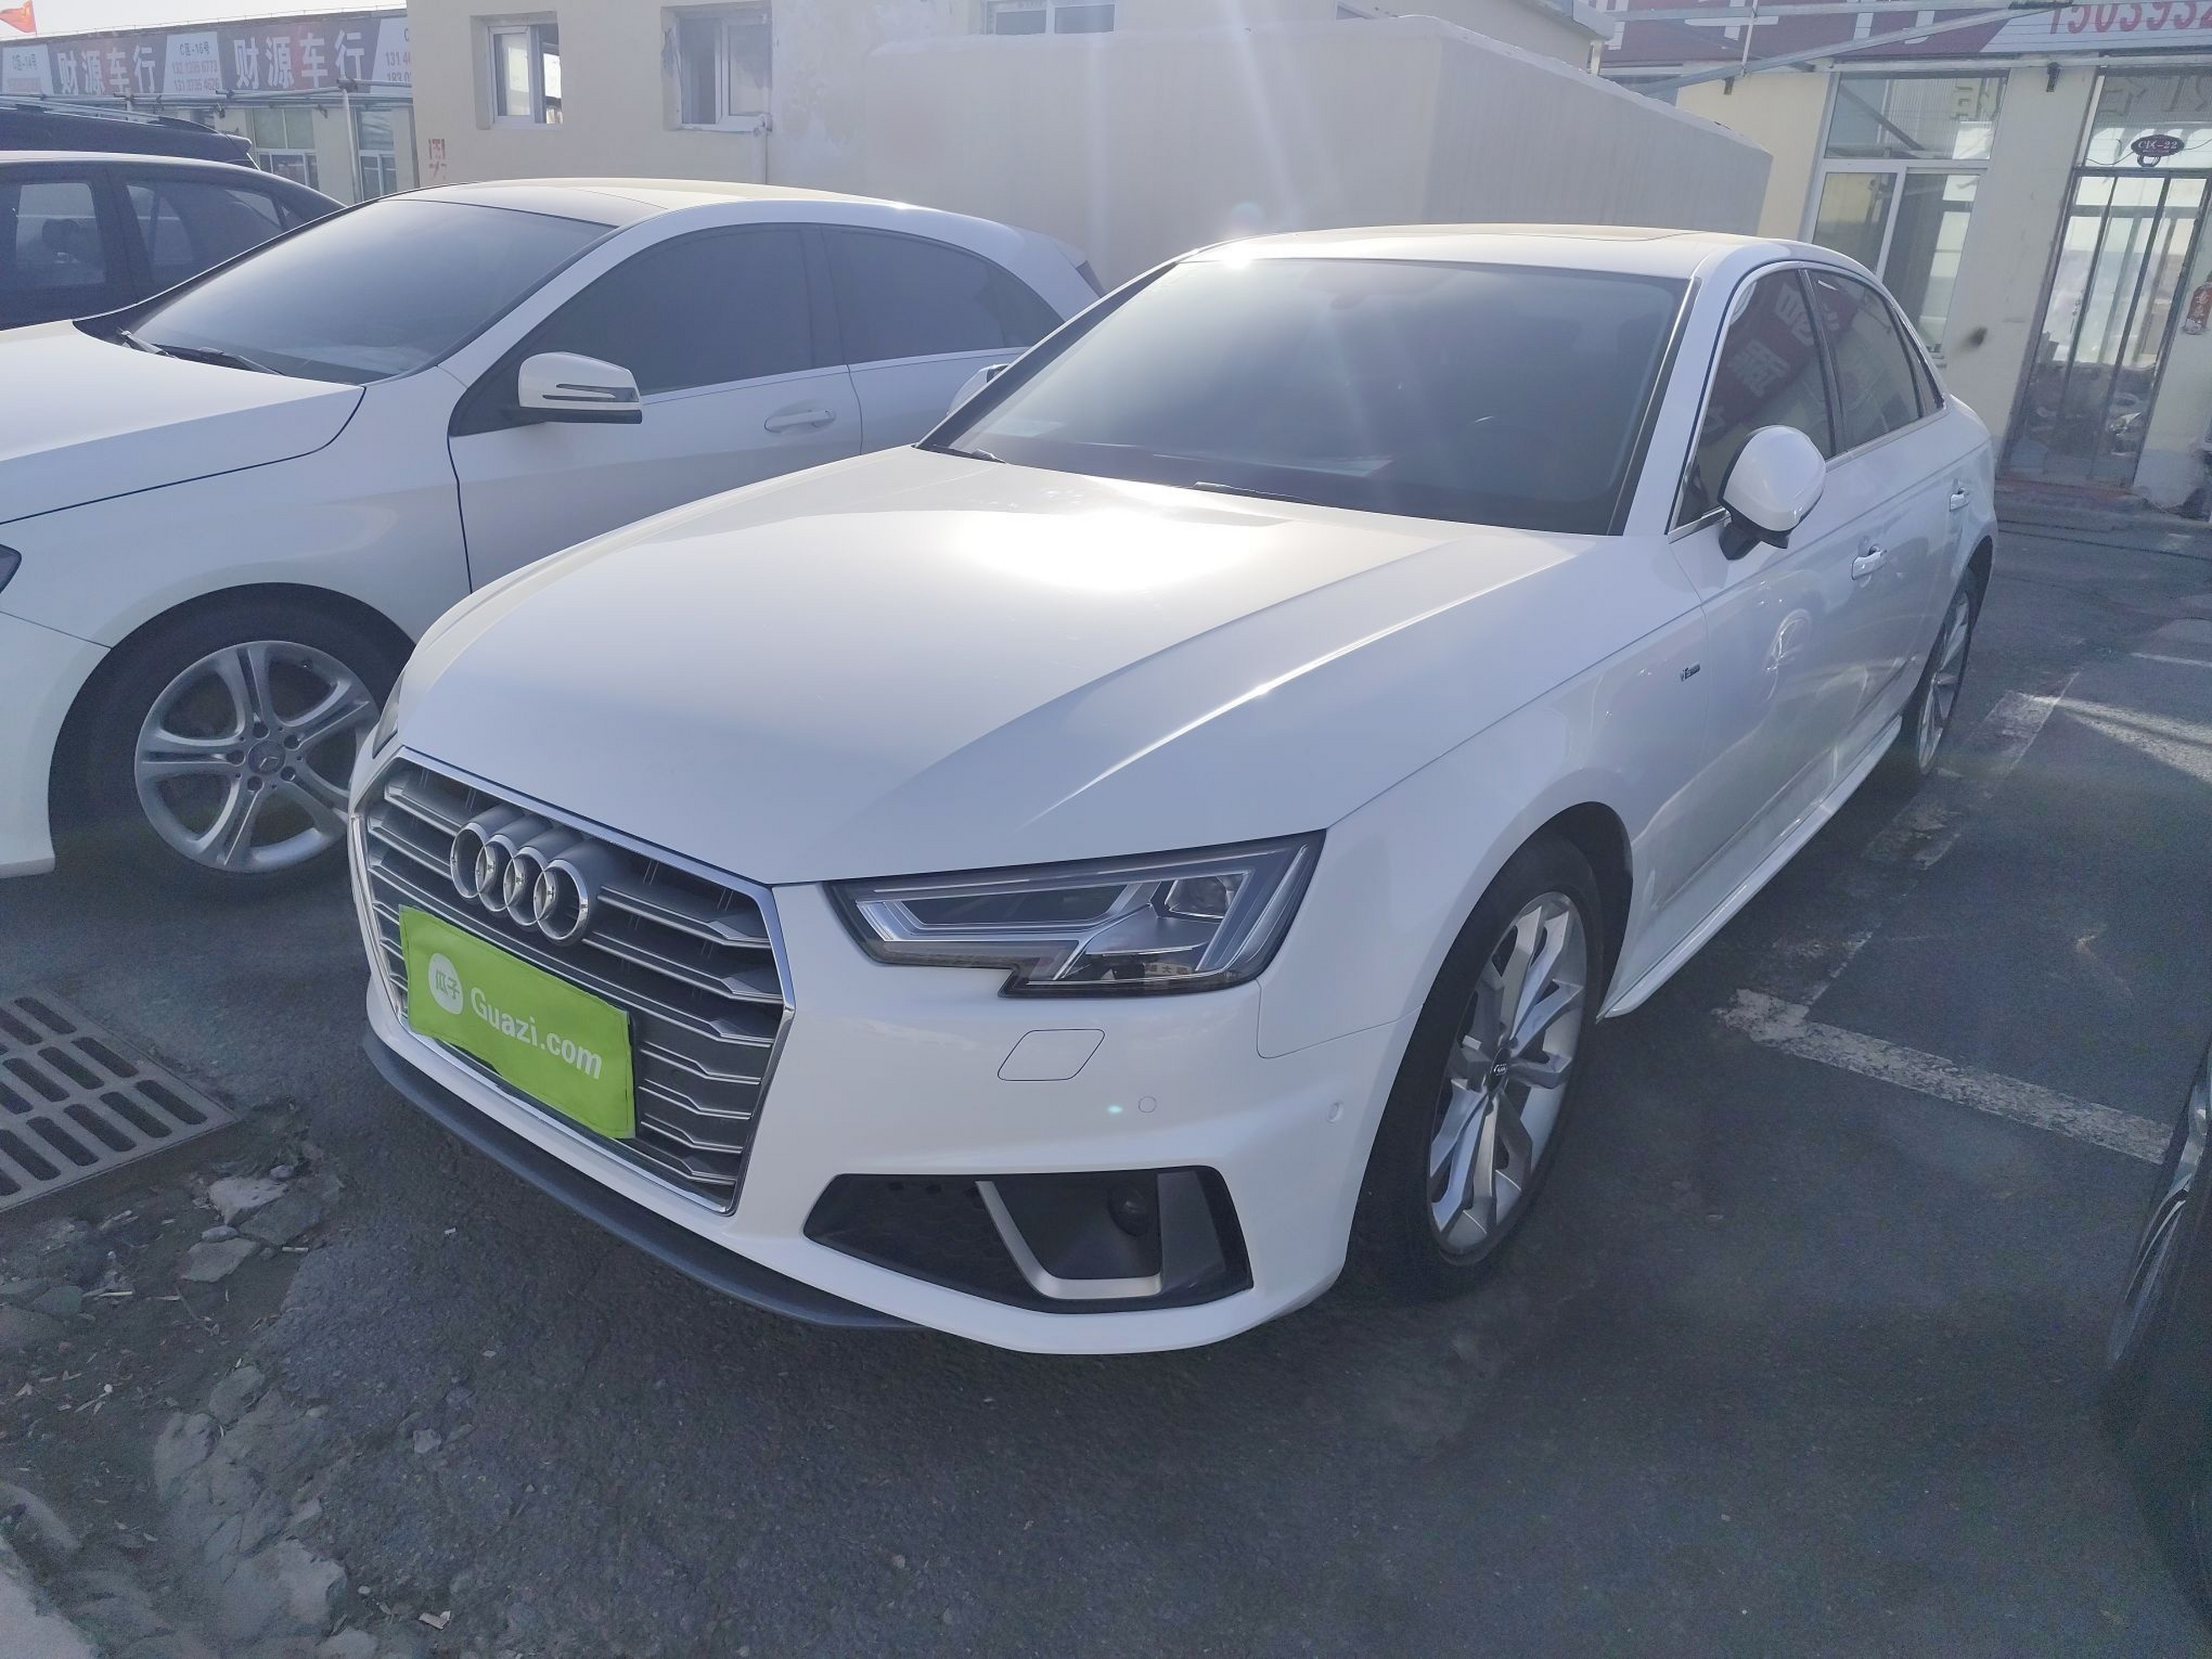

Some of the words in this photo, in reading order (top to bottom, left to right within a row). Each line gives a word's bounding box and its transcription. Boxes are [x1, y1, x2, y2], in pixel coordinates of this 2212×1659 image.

[57, 43, 156, 96] 财源车行
[233, 29, 365, 90] 财源车行
[435, 969, 460, 1000] 瓜子
[470, 987, 603, 1080] Guazi.com
